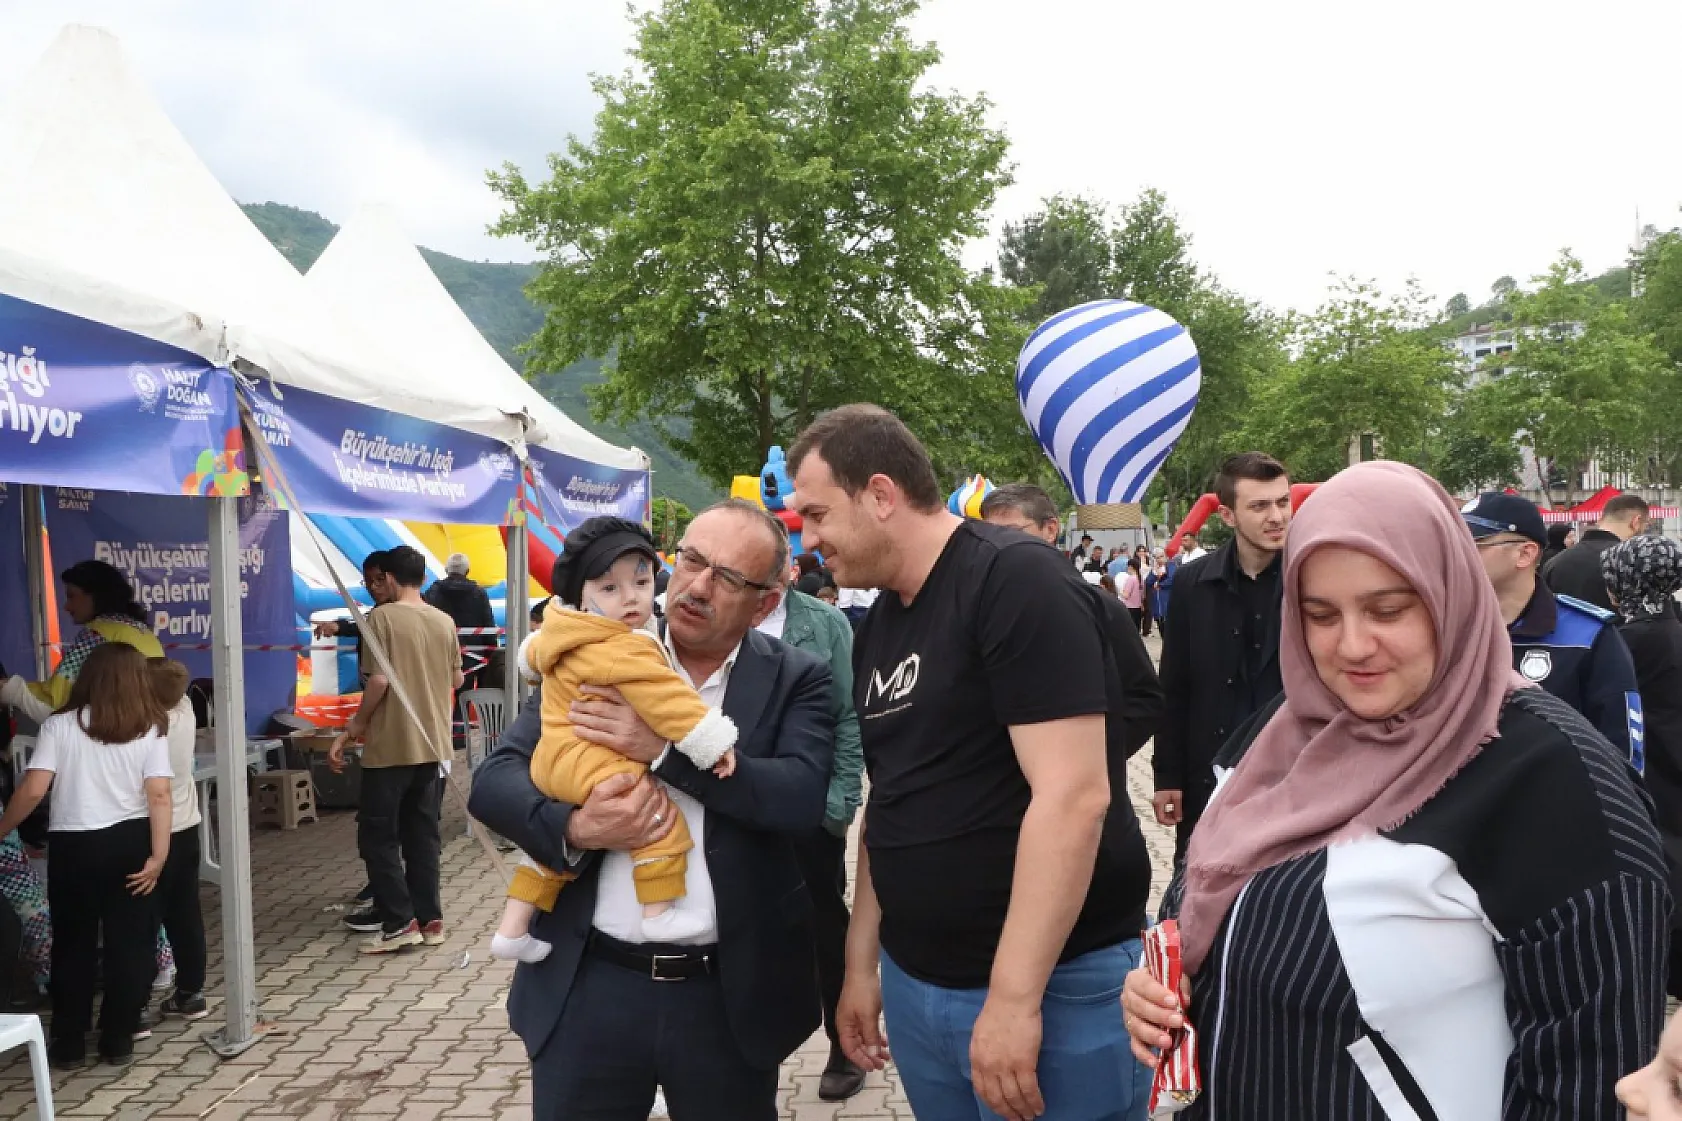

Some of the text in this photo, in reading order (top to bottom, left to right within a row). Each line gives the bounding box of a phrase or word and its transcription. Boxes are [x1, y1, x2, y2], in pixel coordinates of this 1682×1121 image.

[0, 391, 82, 444] rlıyor
[239, 544, 264, 574] şığı
[154, 608, 212, 640] Parlıy
